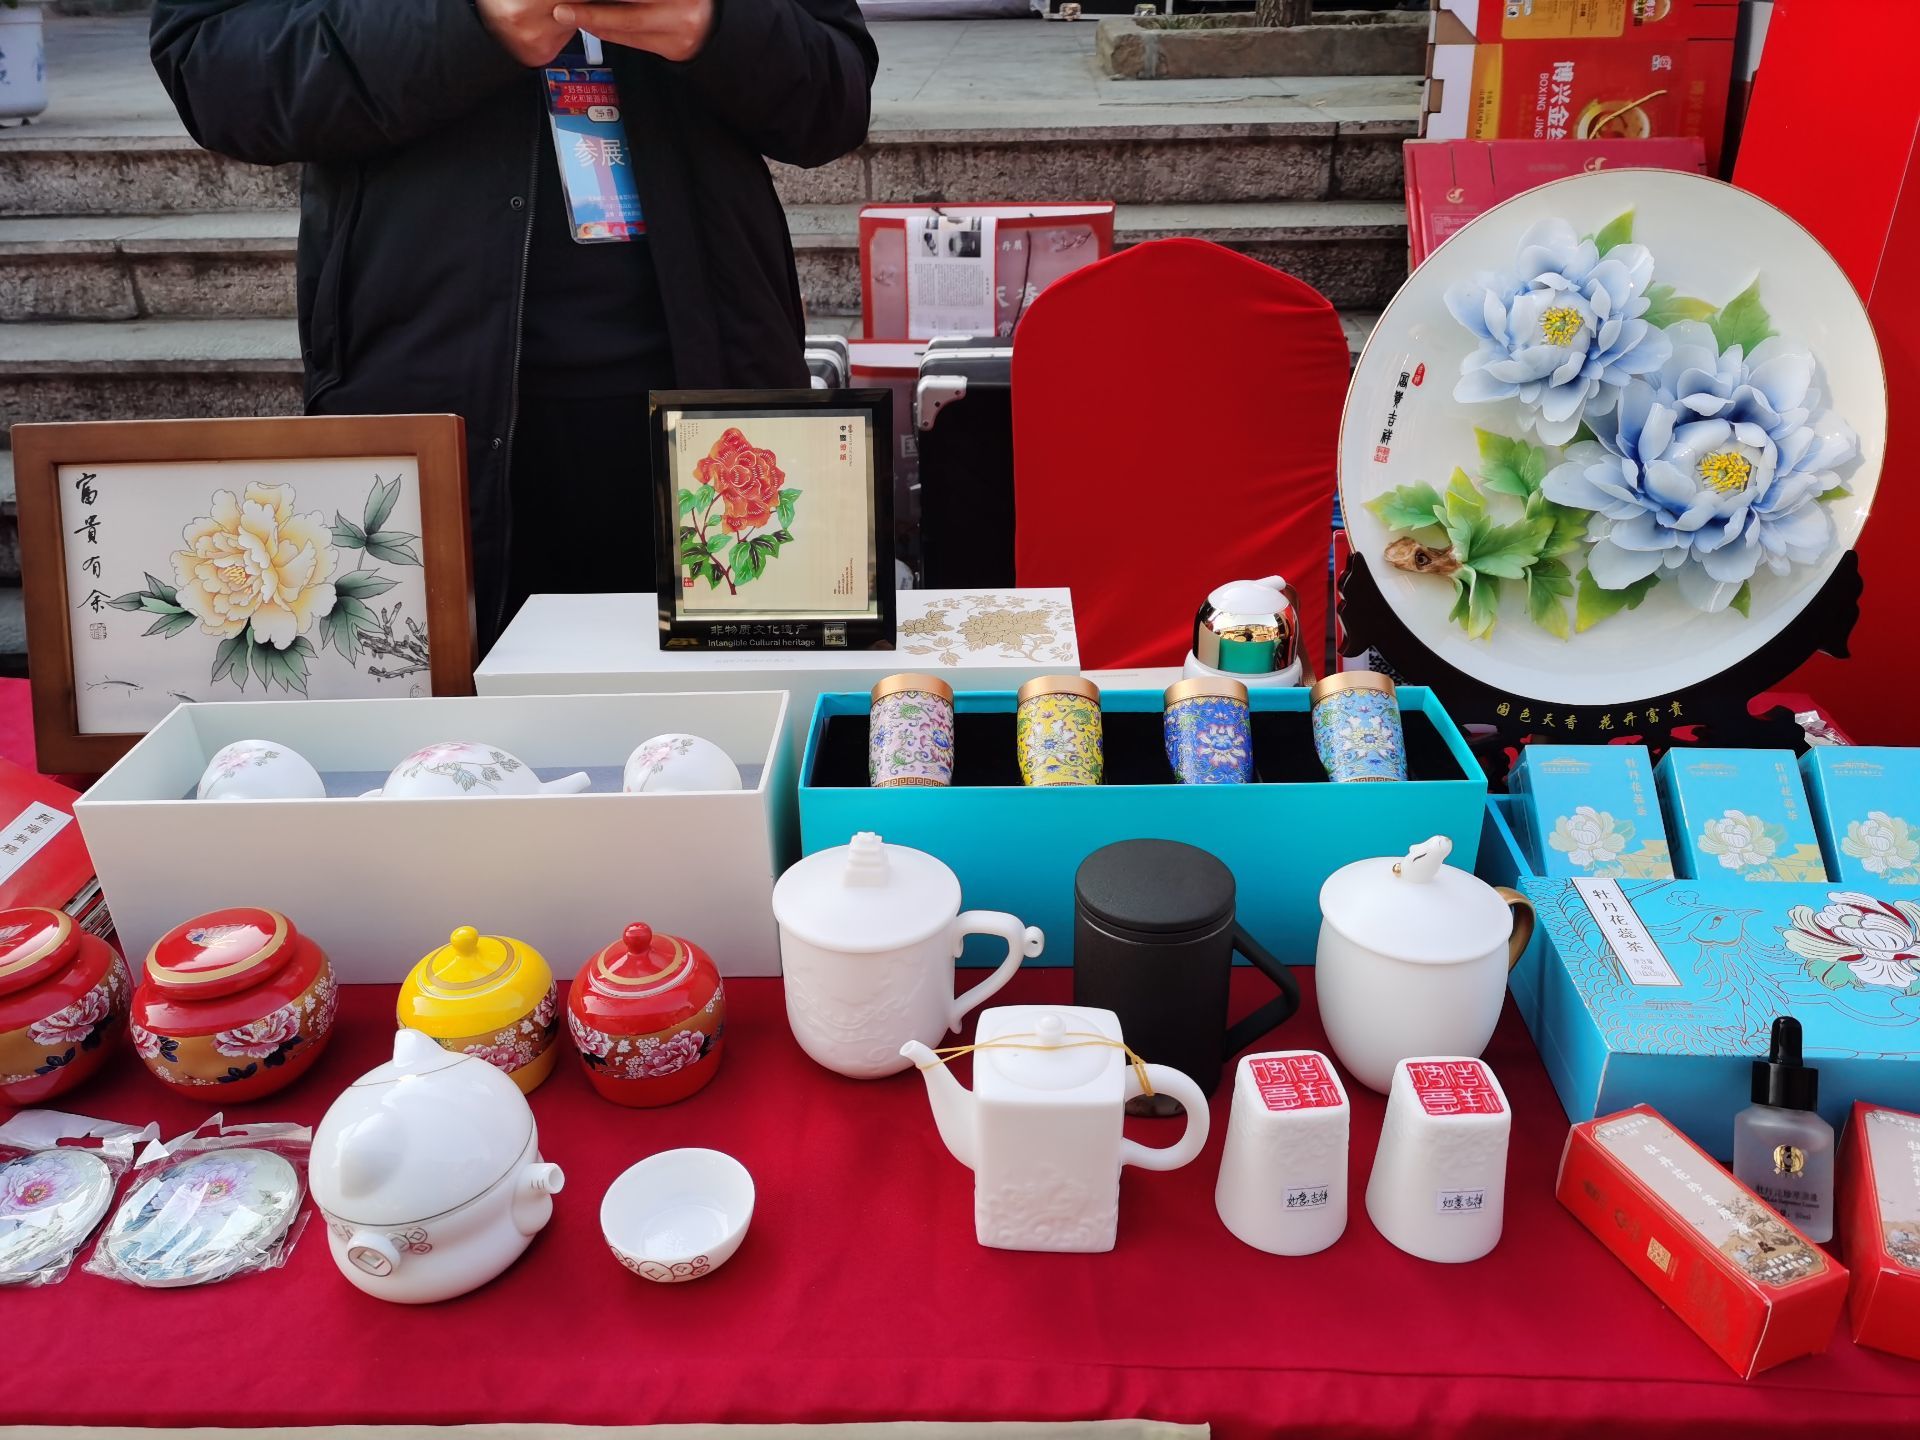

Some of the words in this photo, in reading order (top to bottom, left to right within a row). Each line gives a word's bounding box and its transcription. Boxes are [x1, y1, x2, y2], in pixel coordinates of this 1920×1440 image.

[1536, 73, 1549, 111] BOXING
[573, 139, 628, 167] 参展
[711, 624, 808, 636] 非物质文化遗产
[708, 639, 748, 648] Intangible
[749, 638, 781, 647] Cultural
[782, 637, 815, 647] heritage
